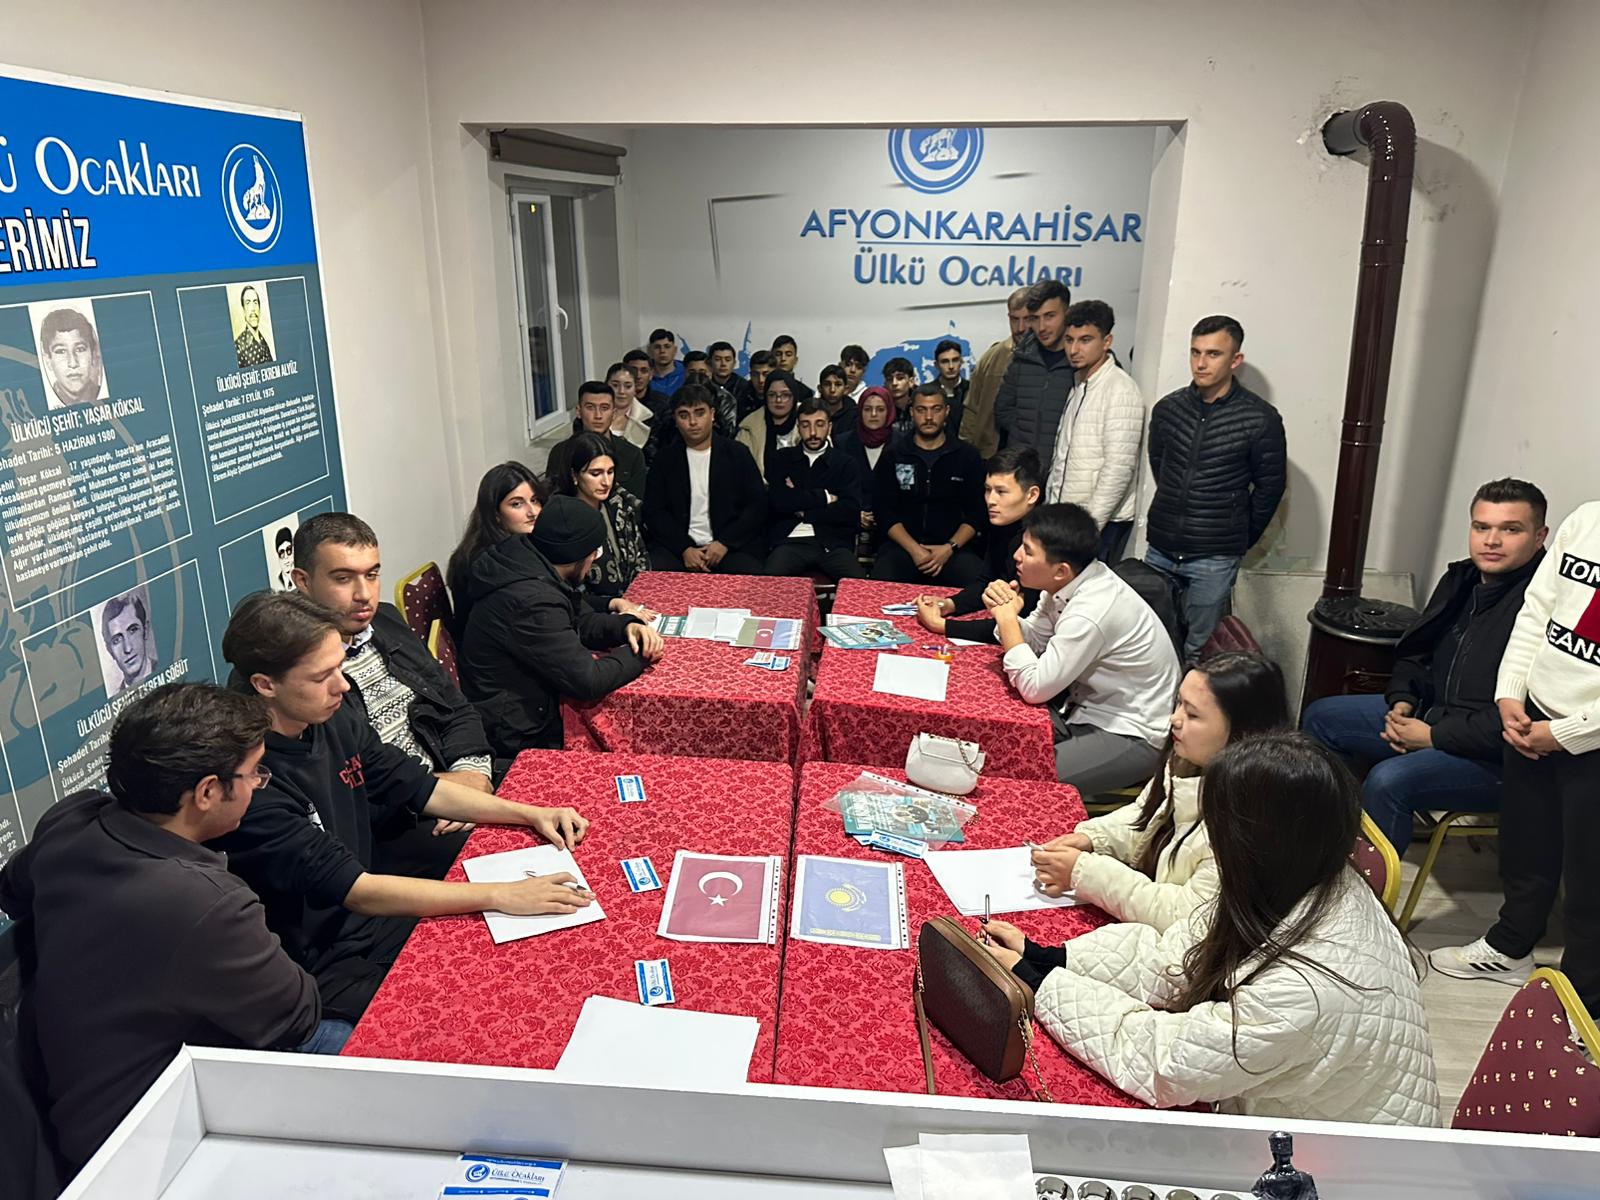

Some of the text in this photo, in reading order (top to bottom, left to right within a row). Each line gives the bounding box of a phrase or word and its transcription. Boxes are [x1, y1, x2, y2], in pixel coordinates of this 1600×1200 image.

[800, 205, 1142, 242] AFYONKARAHİSAR
[11, 398, 144, 442] ÜLKÜCÜ ŞEHİT; YAŞAR KÖKSAL
[0, 453, 27, 470] ehadet
[27, 446, 53, 461] Tarihi:
[62, 435, 96, 452] HAZİRAN
[98, 429, 115, 442] 1980
[0, 480, 15, 495] ehit
[77, 703, 112, 737] ÜLKÜCÜ
[165, 658, 189, 683] SÖĞÜT
[57, 745, 89, 774] Şehadet
[62, 768, 85, 788] Ülkücü
